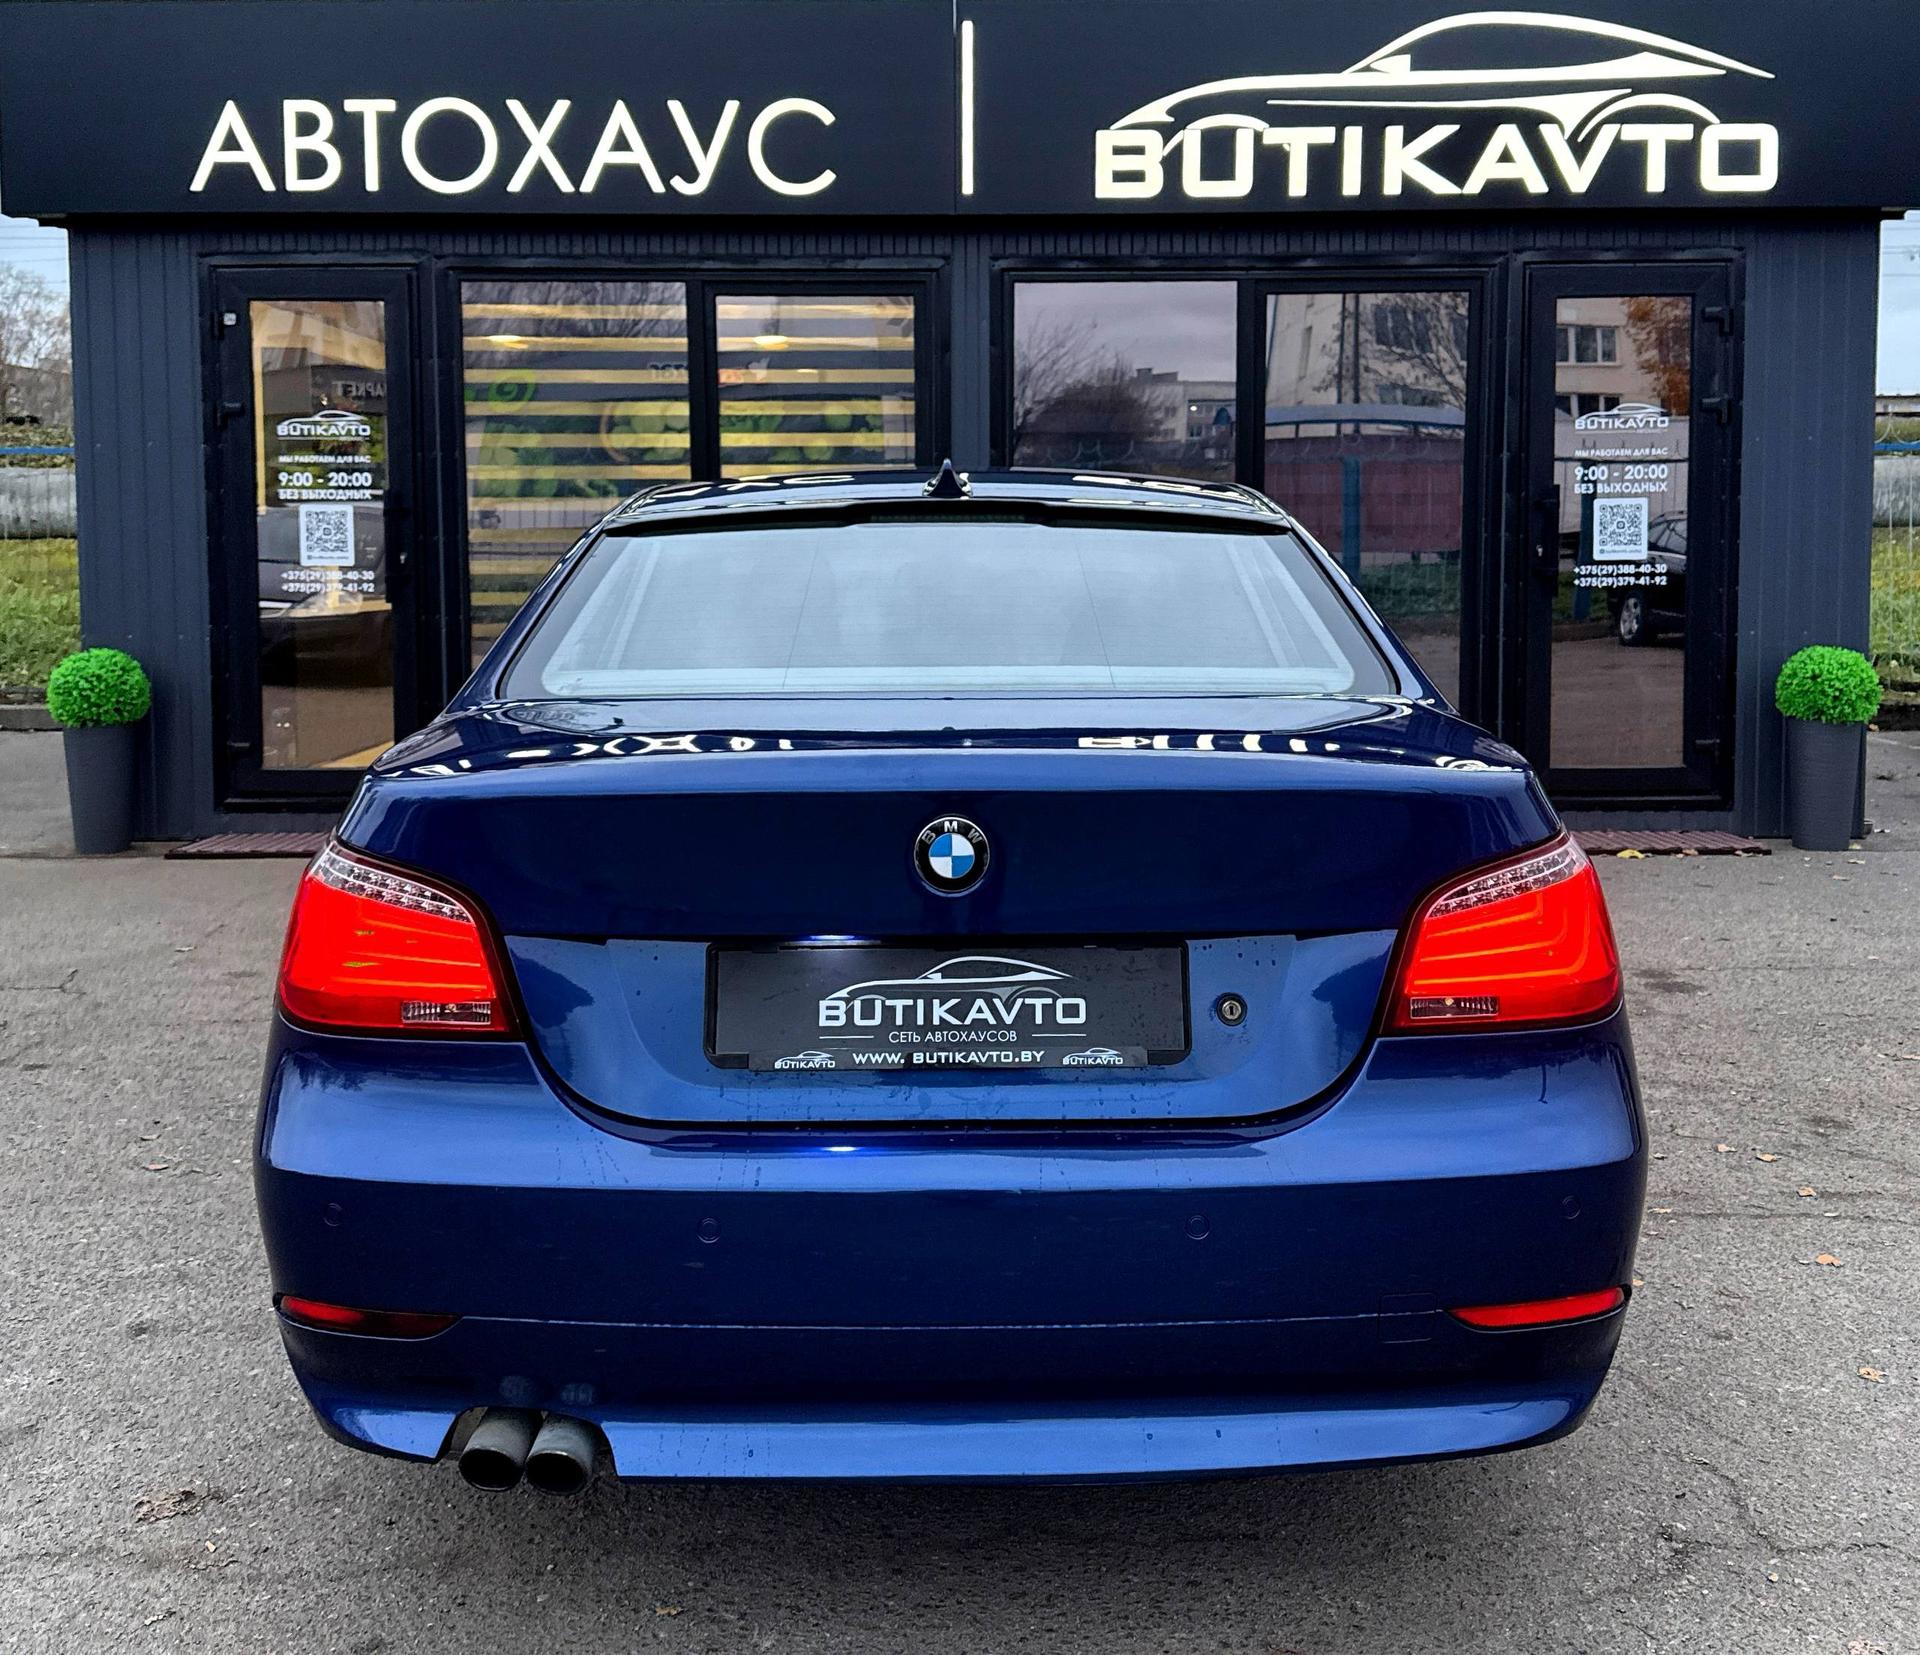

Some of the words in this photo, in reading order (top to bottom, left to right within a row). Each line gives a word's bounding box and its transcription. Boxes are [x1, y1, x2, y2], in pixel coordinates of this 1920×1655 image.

[189, 96, 838, 196] АВТОХАУС
[1094, 121, 1779, 199] BUTIKAVTO
[276, 424, 371, 436] BUTIKAVTO
[1574, 416, 1670, 430] BUTIKAVTO
[278, 471, 313, 487] 9:00
[327, 471, 373, 487] 20:00
[1574, 466, 1608, 481] 9:00
[1624, 464, 1668, 480] 20:00
[278, 488, 299, 500] БЕЗ
[302, 488, 372, 500] ВЫХОДНЫХ
[1574, 483, 1594, 494] БЕЗ
[1597, 481, 1668, 494] ВЫХОДНЫХ
[921, 820, 984, 845] BMW
[818, 997, 1087, 1027] BUTIKAVTO
[888, 1030, 921, 1044] СЕТЬ
[924, 1029, 1018, 1044] АВТОХАУСОВ
[852, 1051, 905, 1065] WWW.
[912, 1049, 1046, 1065] BUTIKAVTO.BY
[1062, 1055, 1124, 1066] BUTIKAVTO
[774, 1060, 836, 1070] BUTIKAVTO
